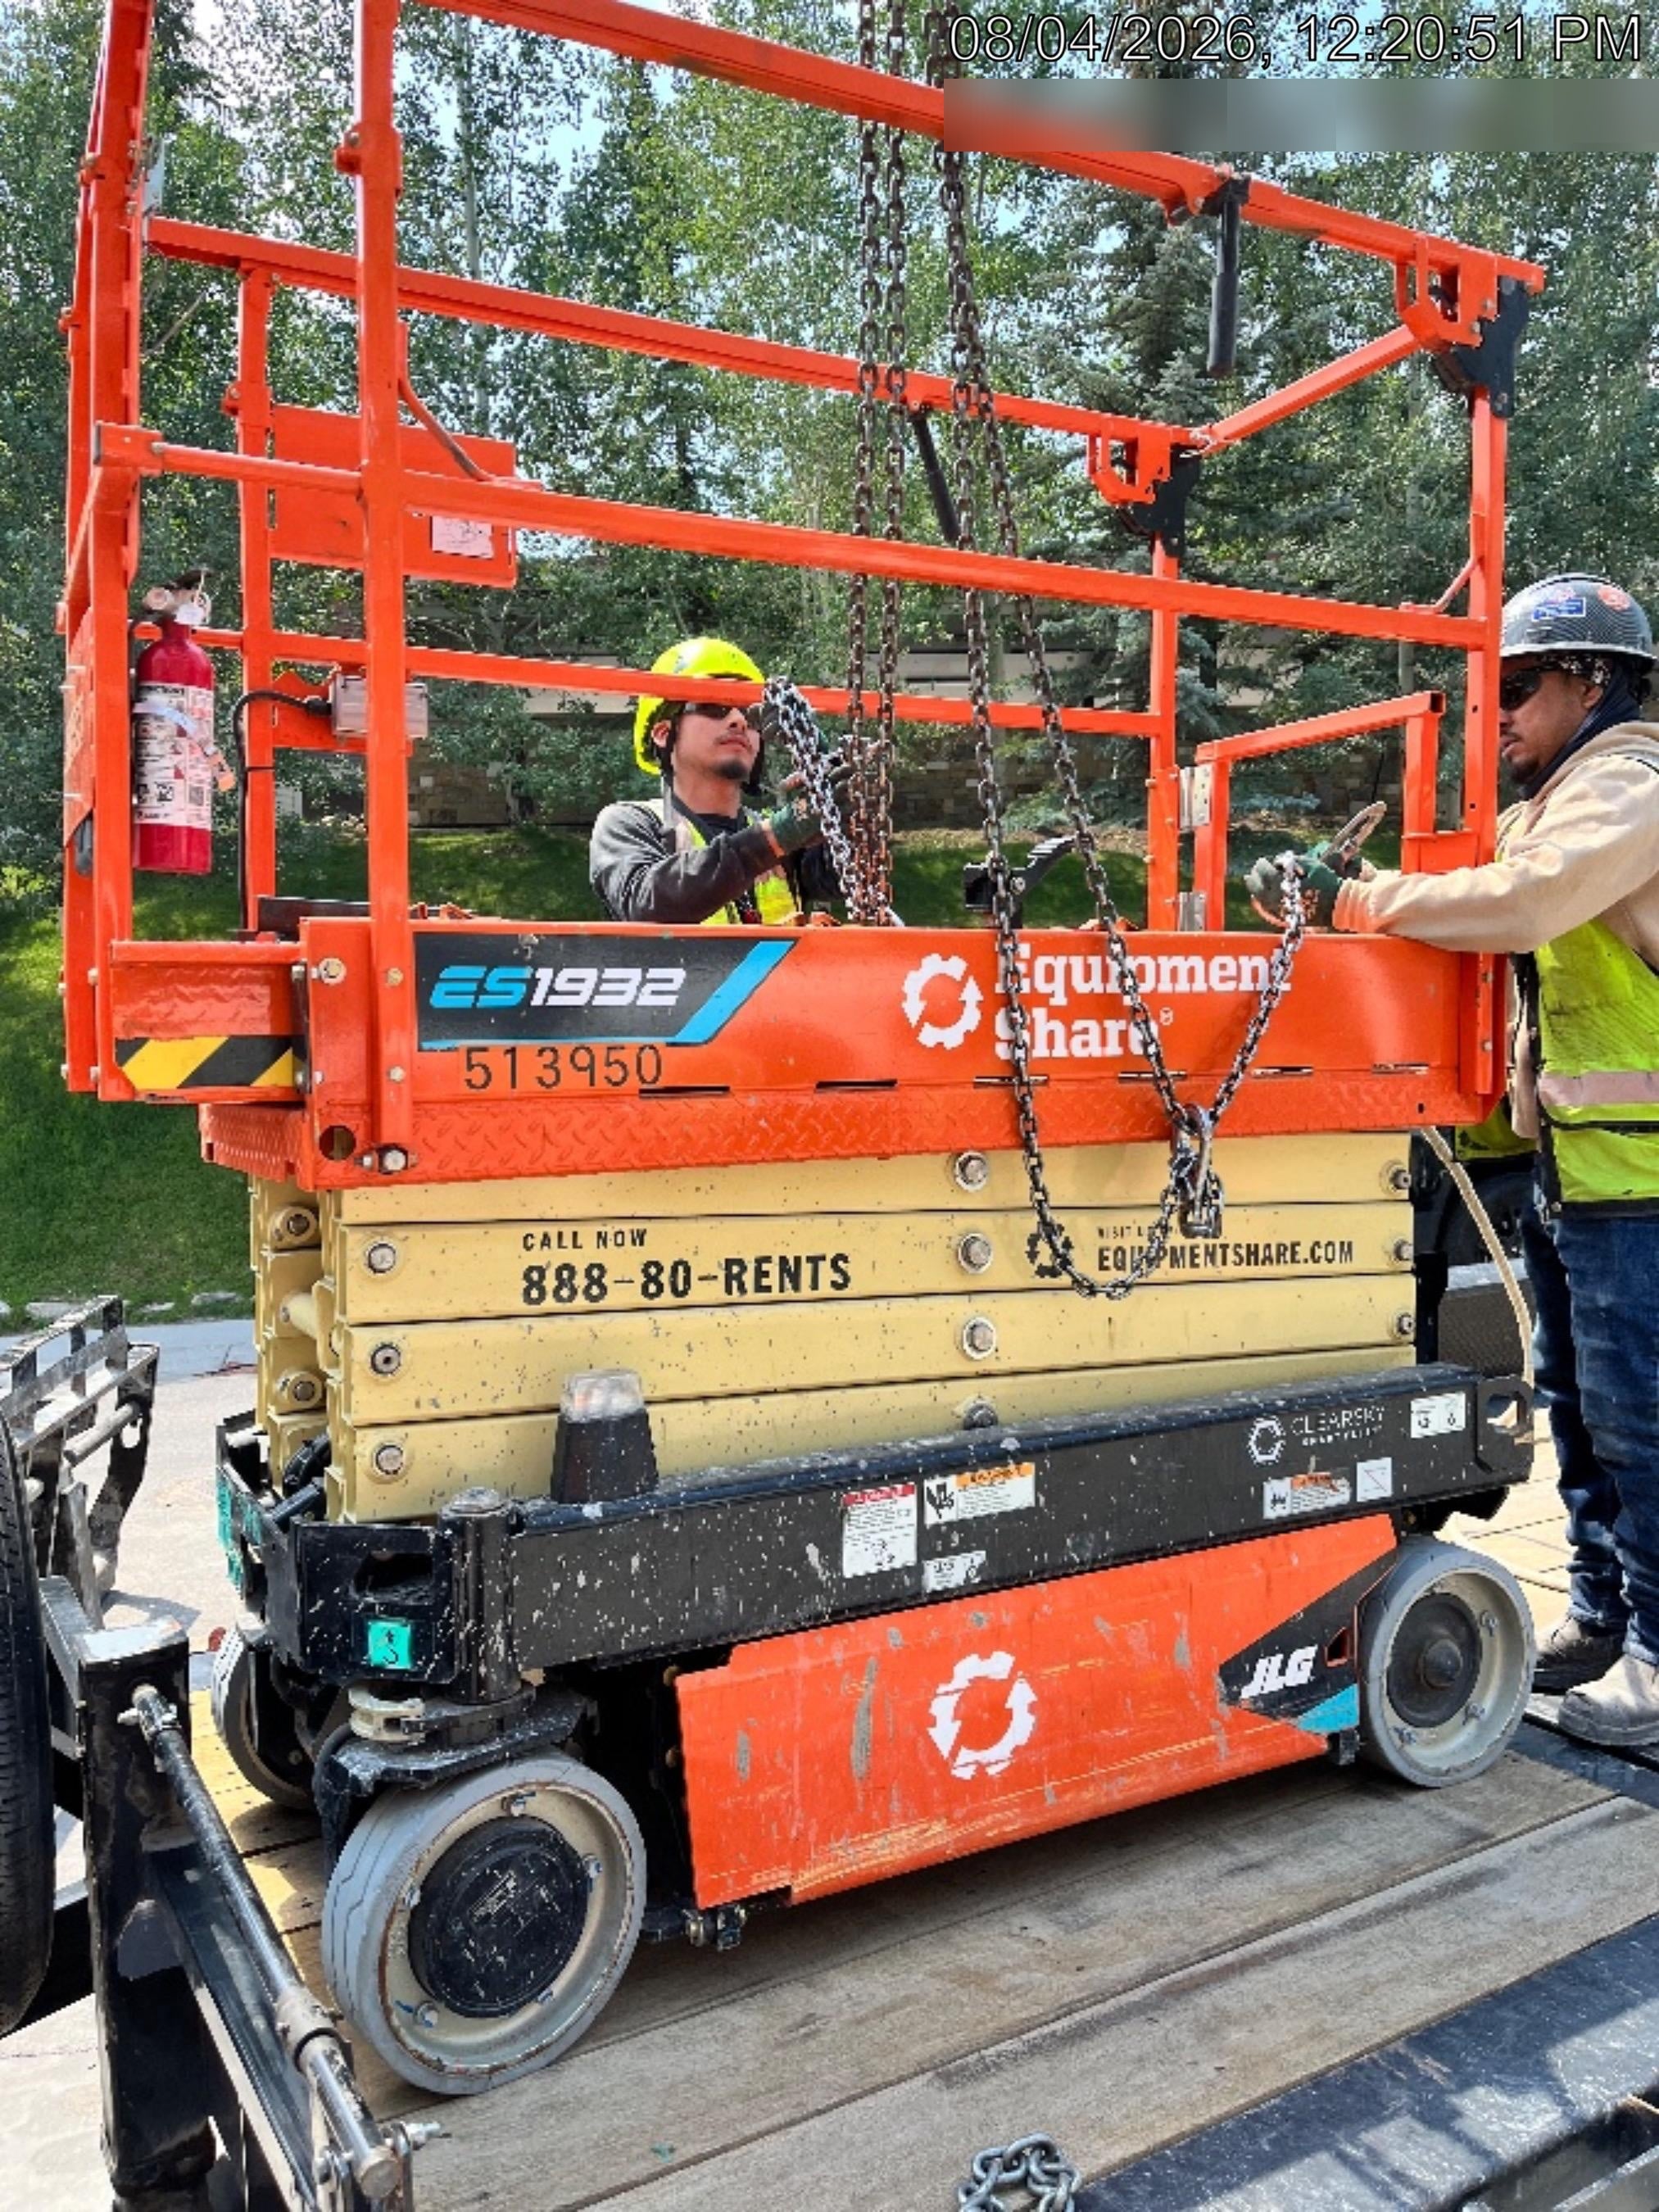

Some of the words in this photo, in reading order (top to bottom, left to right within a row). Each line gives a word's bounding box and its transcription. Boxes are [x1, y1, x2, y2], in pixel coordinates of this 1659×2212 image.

[429, 965, 687, 1009] ES1932
[465, 1045, 662, 1090] 513950
[523, 1231, 583, 1251] CALL
[596, 1229, 647, 1249] NOW
[1098, 1240, 1354, 1271] EQUPMENTSHARE.COM
[522, 1253, 852, 1306] 888-80-RENTS
[1240, 1643, 1319, 1700] JLG
